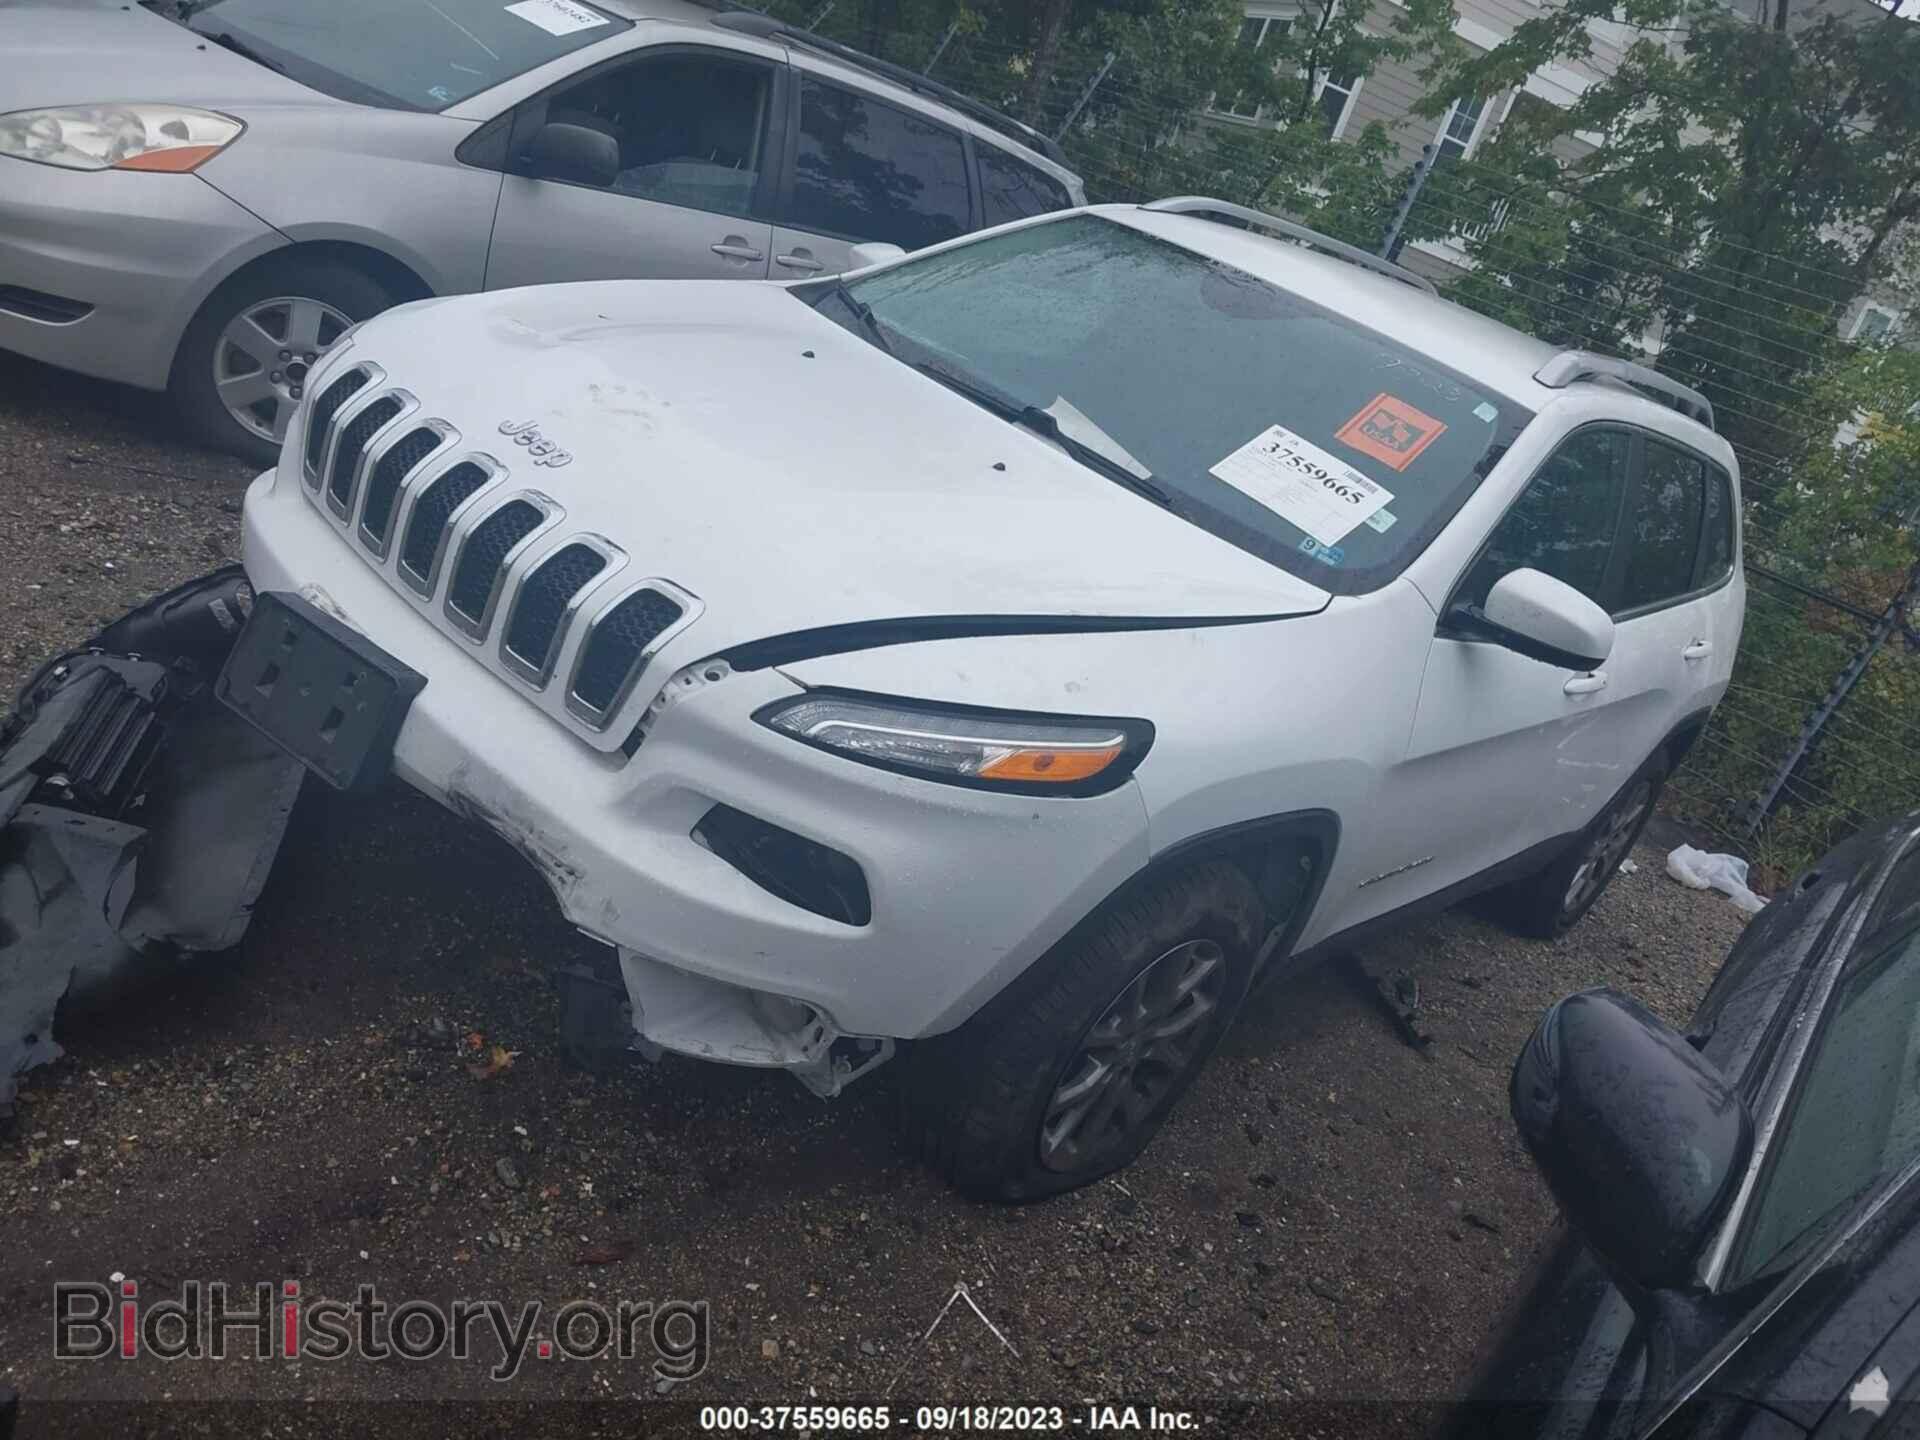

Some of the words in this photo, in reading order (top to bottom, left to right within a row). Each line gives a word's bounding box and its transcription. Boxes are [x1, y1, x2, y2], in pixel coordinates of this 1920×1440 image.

[498, 419, 573, 468] Jeep
[1262, 440, 1365, 504] 37559665
[1303, 539, 1316, 551] 9
